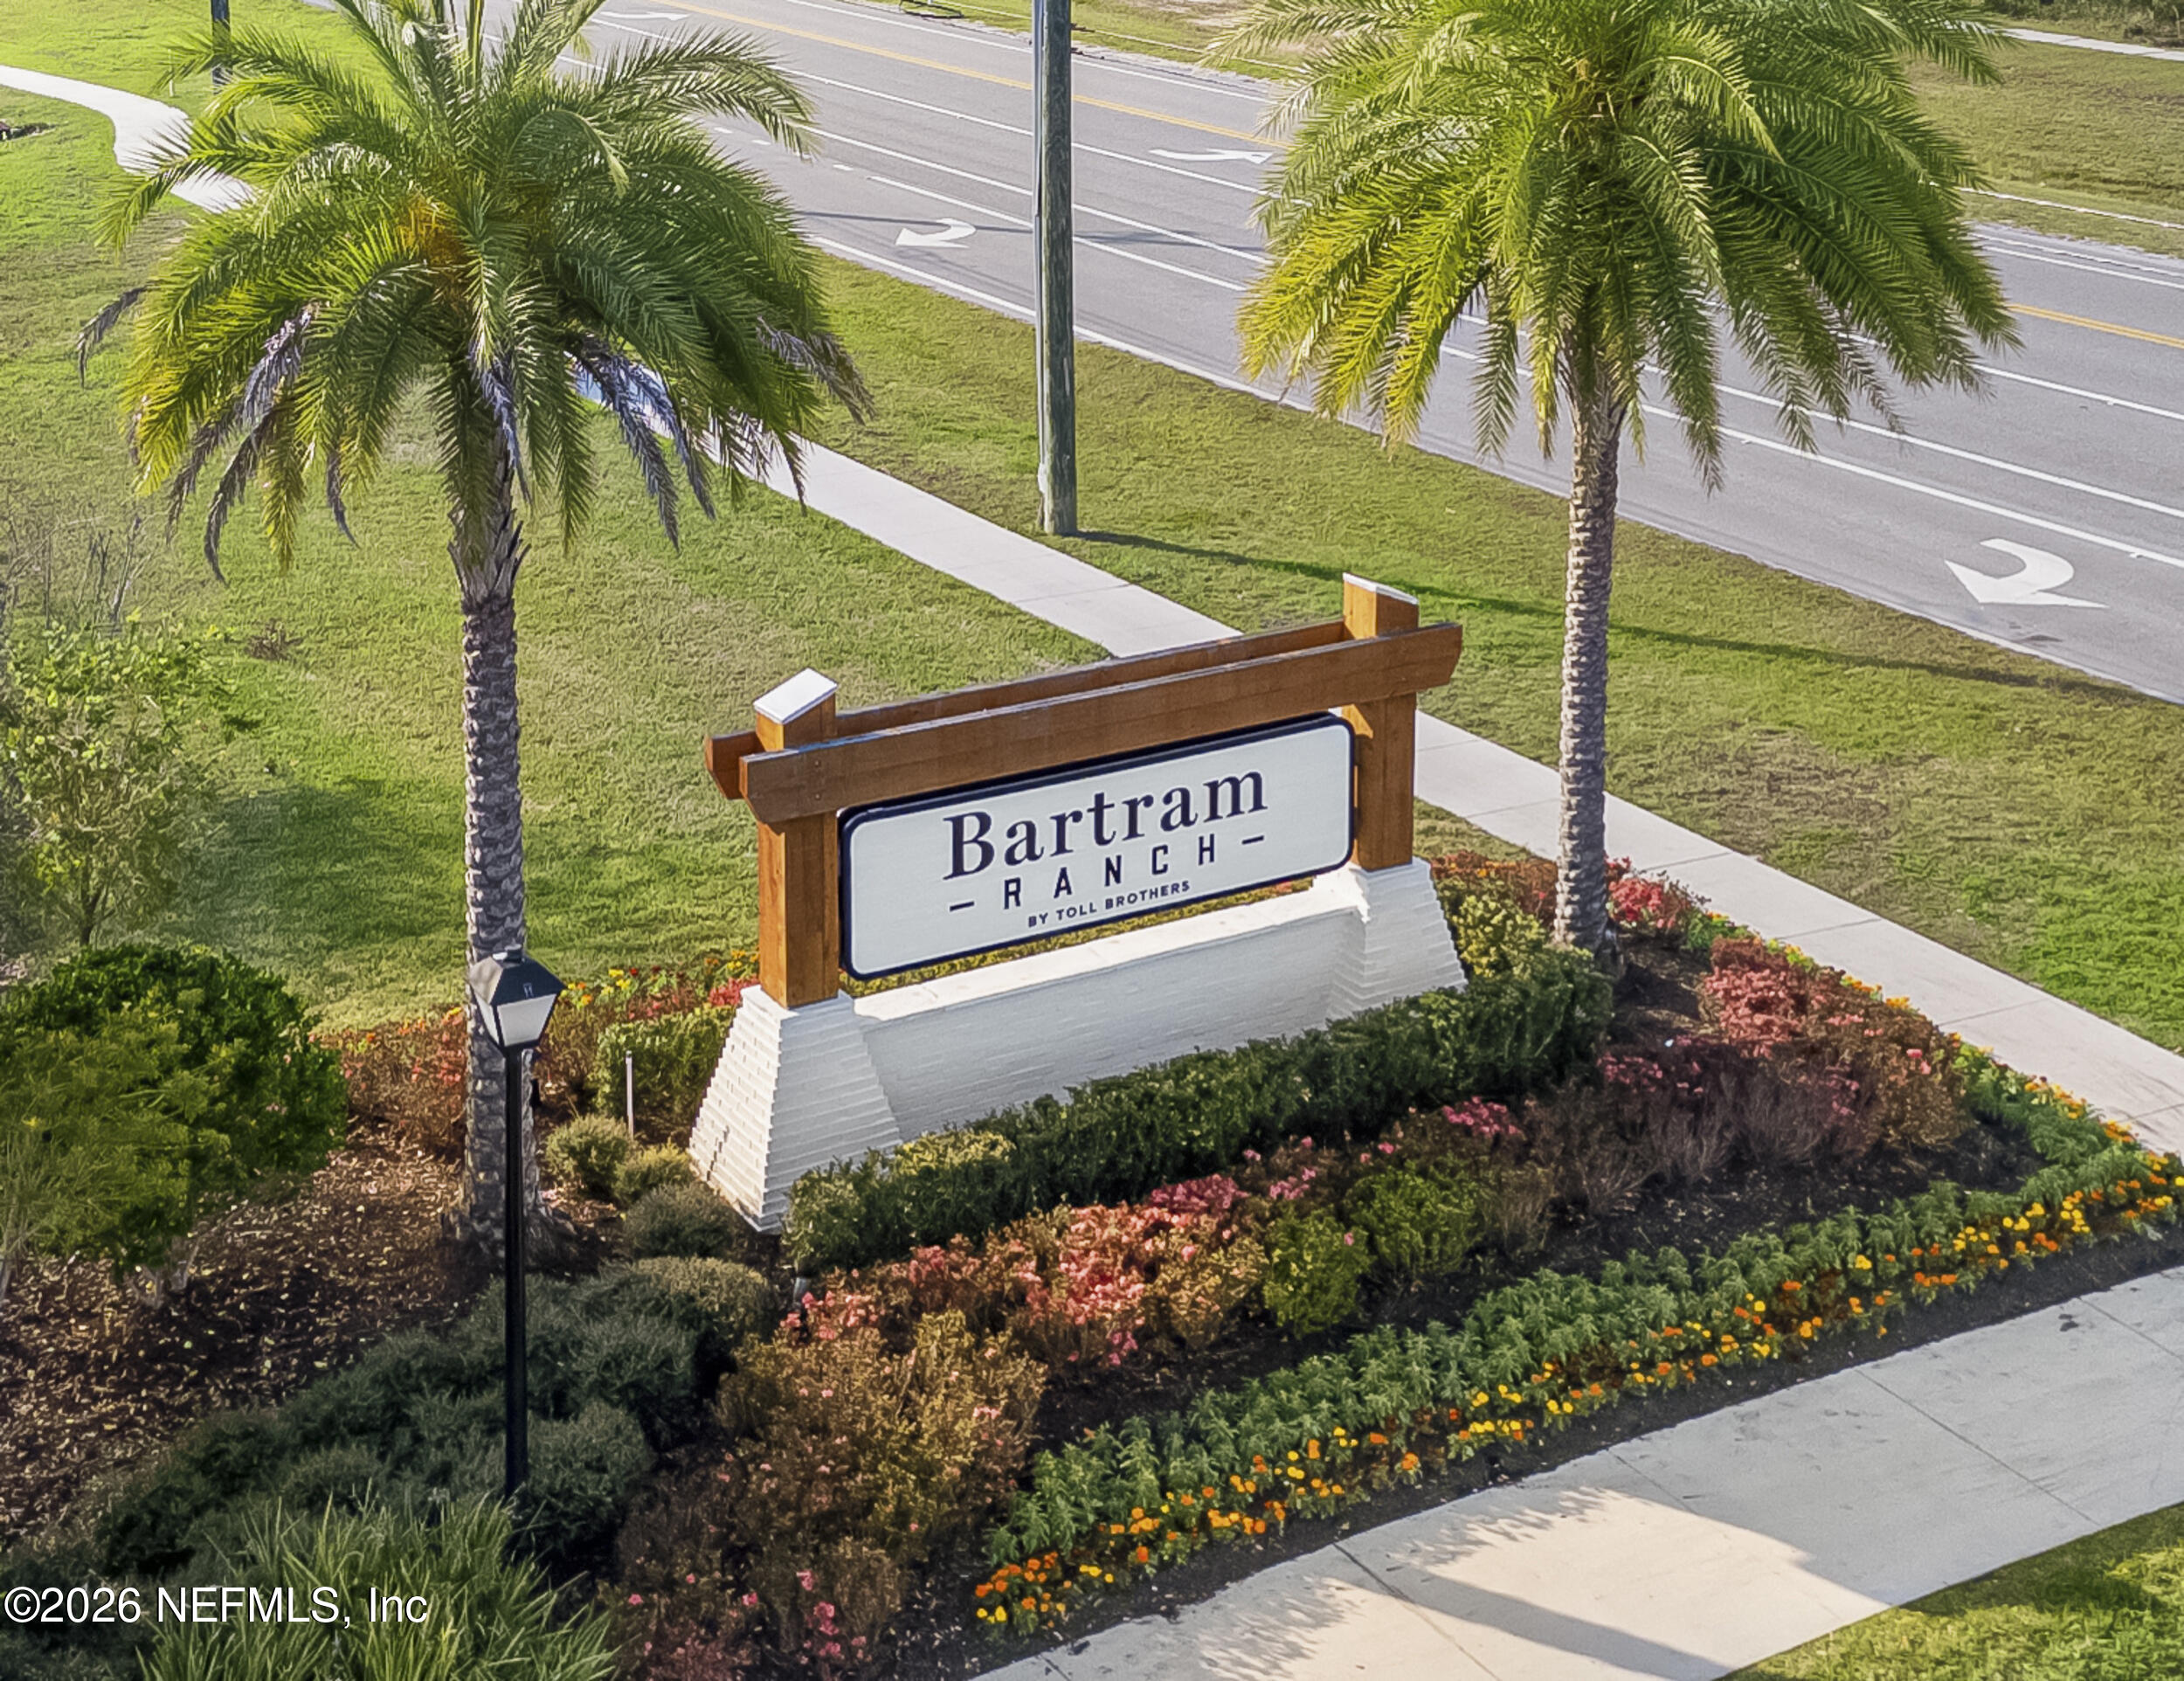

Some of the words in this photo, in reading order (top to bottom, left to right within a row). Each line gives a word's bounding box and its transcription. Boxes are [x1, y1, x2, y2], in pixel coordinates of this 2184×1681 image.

[943, 771, 1268, 880] Bartram
[1004, 834, 1215, 910] RANCH
[1028, 912, 1048, 928] BY
[1056, 903, 1097, 921] TOLL
[1105, 880, 1191, 910] BROTHERS
